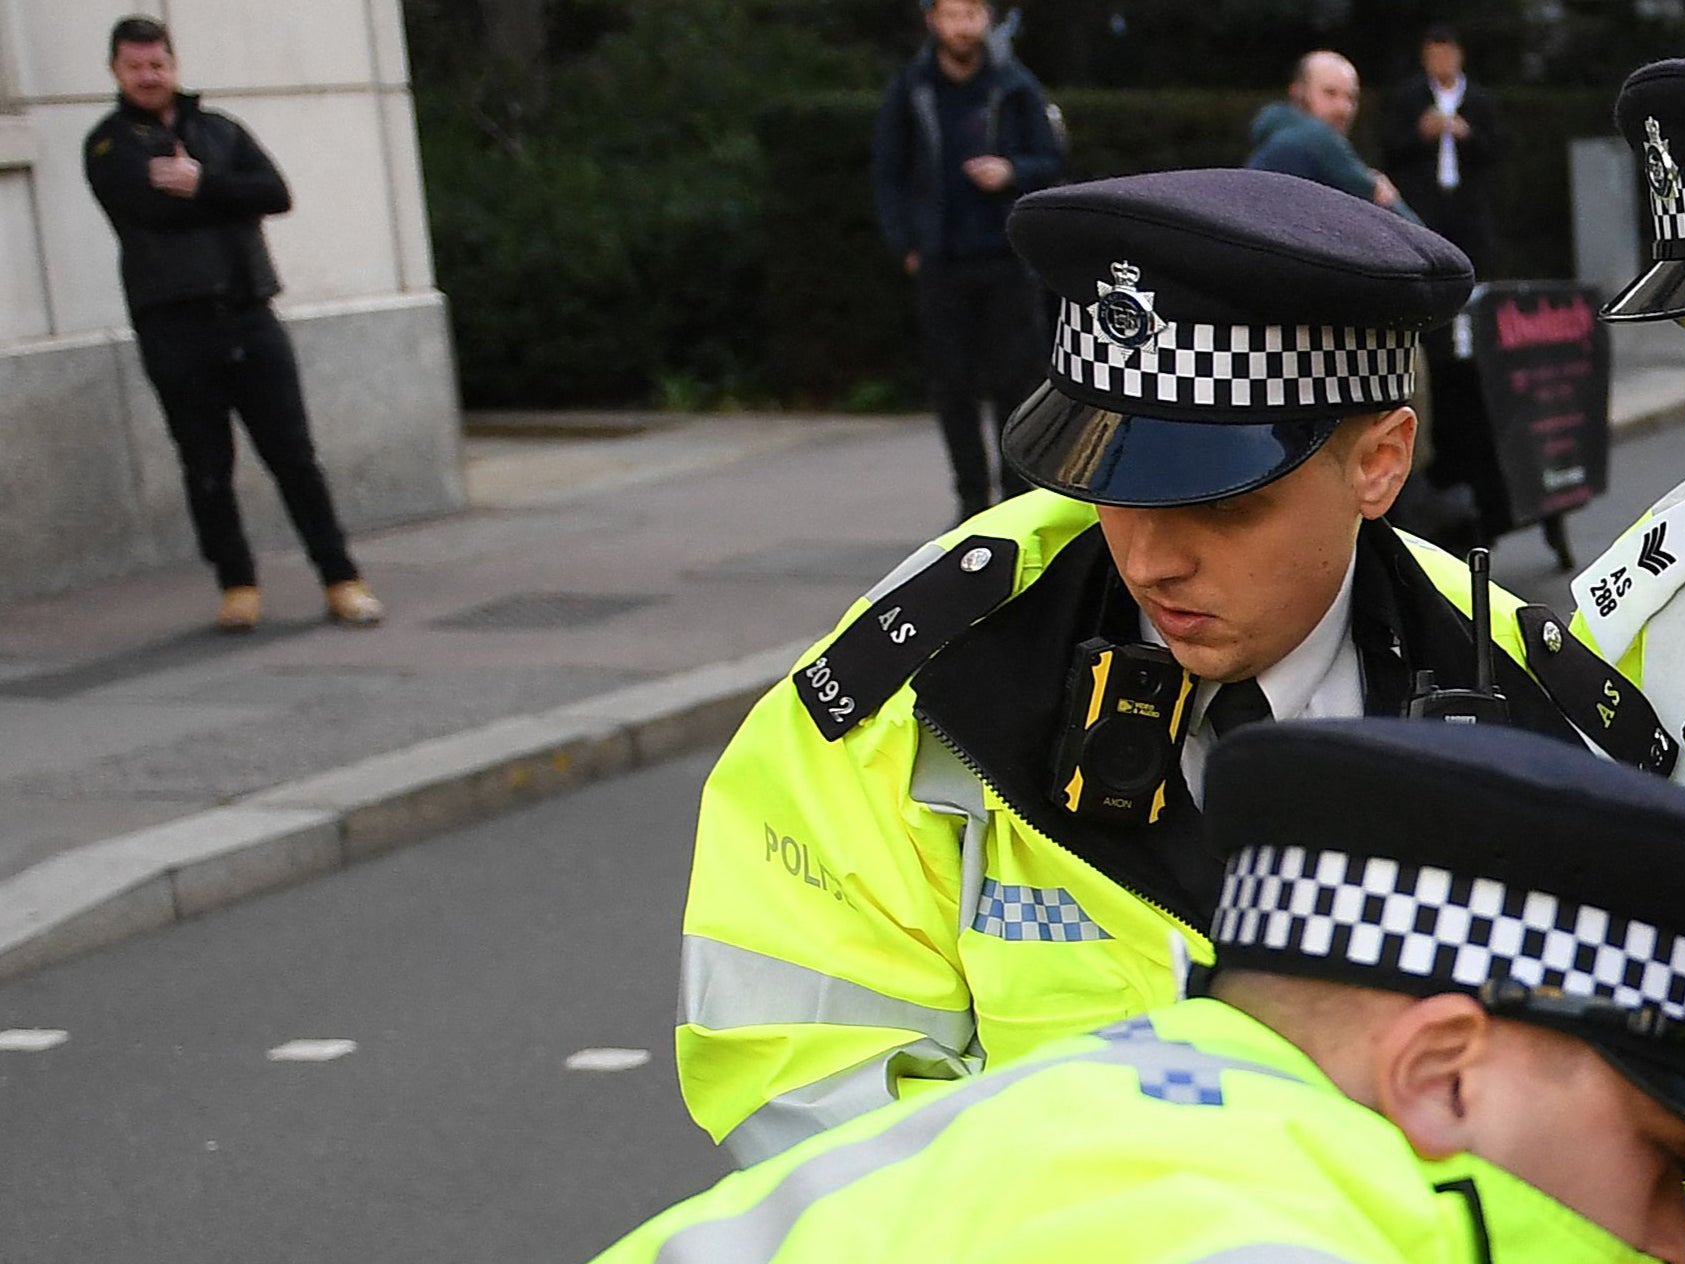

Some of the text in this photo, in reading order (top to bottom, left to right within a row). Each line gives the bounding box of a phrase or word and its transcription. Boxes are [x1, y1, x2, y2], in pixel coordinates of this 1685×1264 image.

[1589, 578, 1618, 617] 288
[1609, 566, 1632, 598] AS
[878, 606, 917, 644] AS
[805, 657, 856, 723] 2092
[1596, 679, 1620, 729] AS
[1103, 797, 1133, 809] AXON
